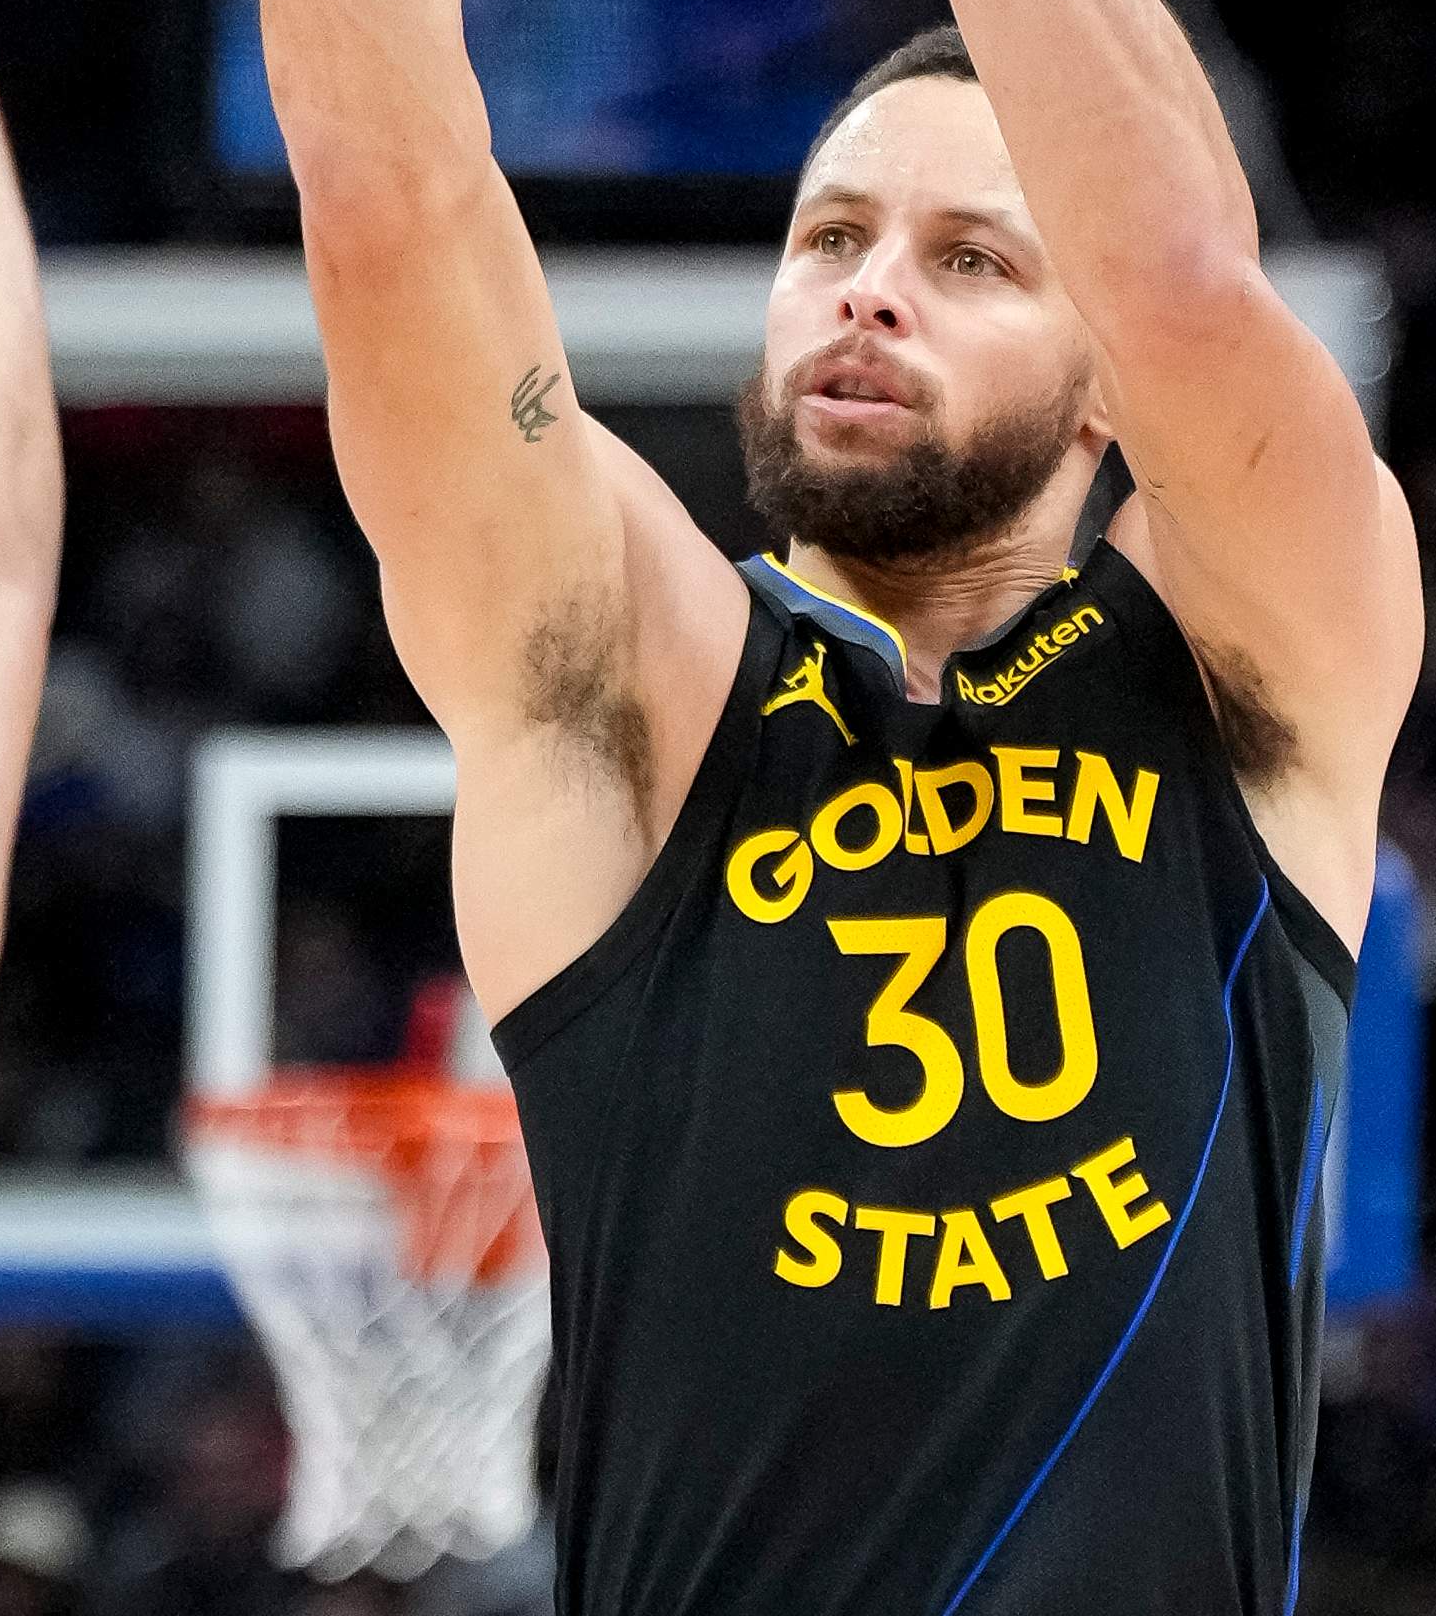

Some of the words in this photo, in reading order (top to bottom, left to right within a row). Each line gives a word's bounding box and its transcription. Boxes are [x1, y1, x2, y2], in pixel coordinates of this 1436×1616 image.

[956, 605, 1105, 706] Rakuten
[726, 747, 1160, 924] GOLDEN
[826, 892, 1099, 1149] 30
[774, 1136, 1170, 1310] STATE
